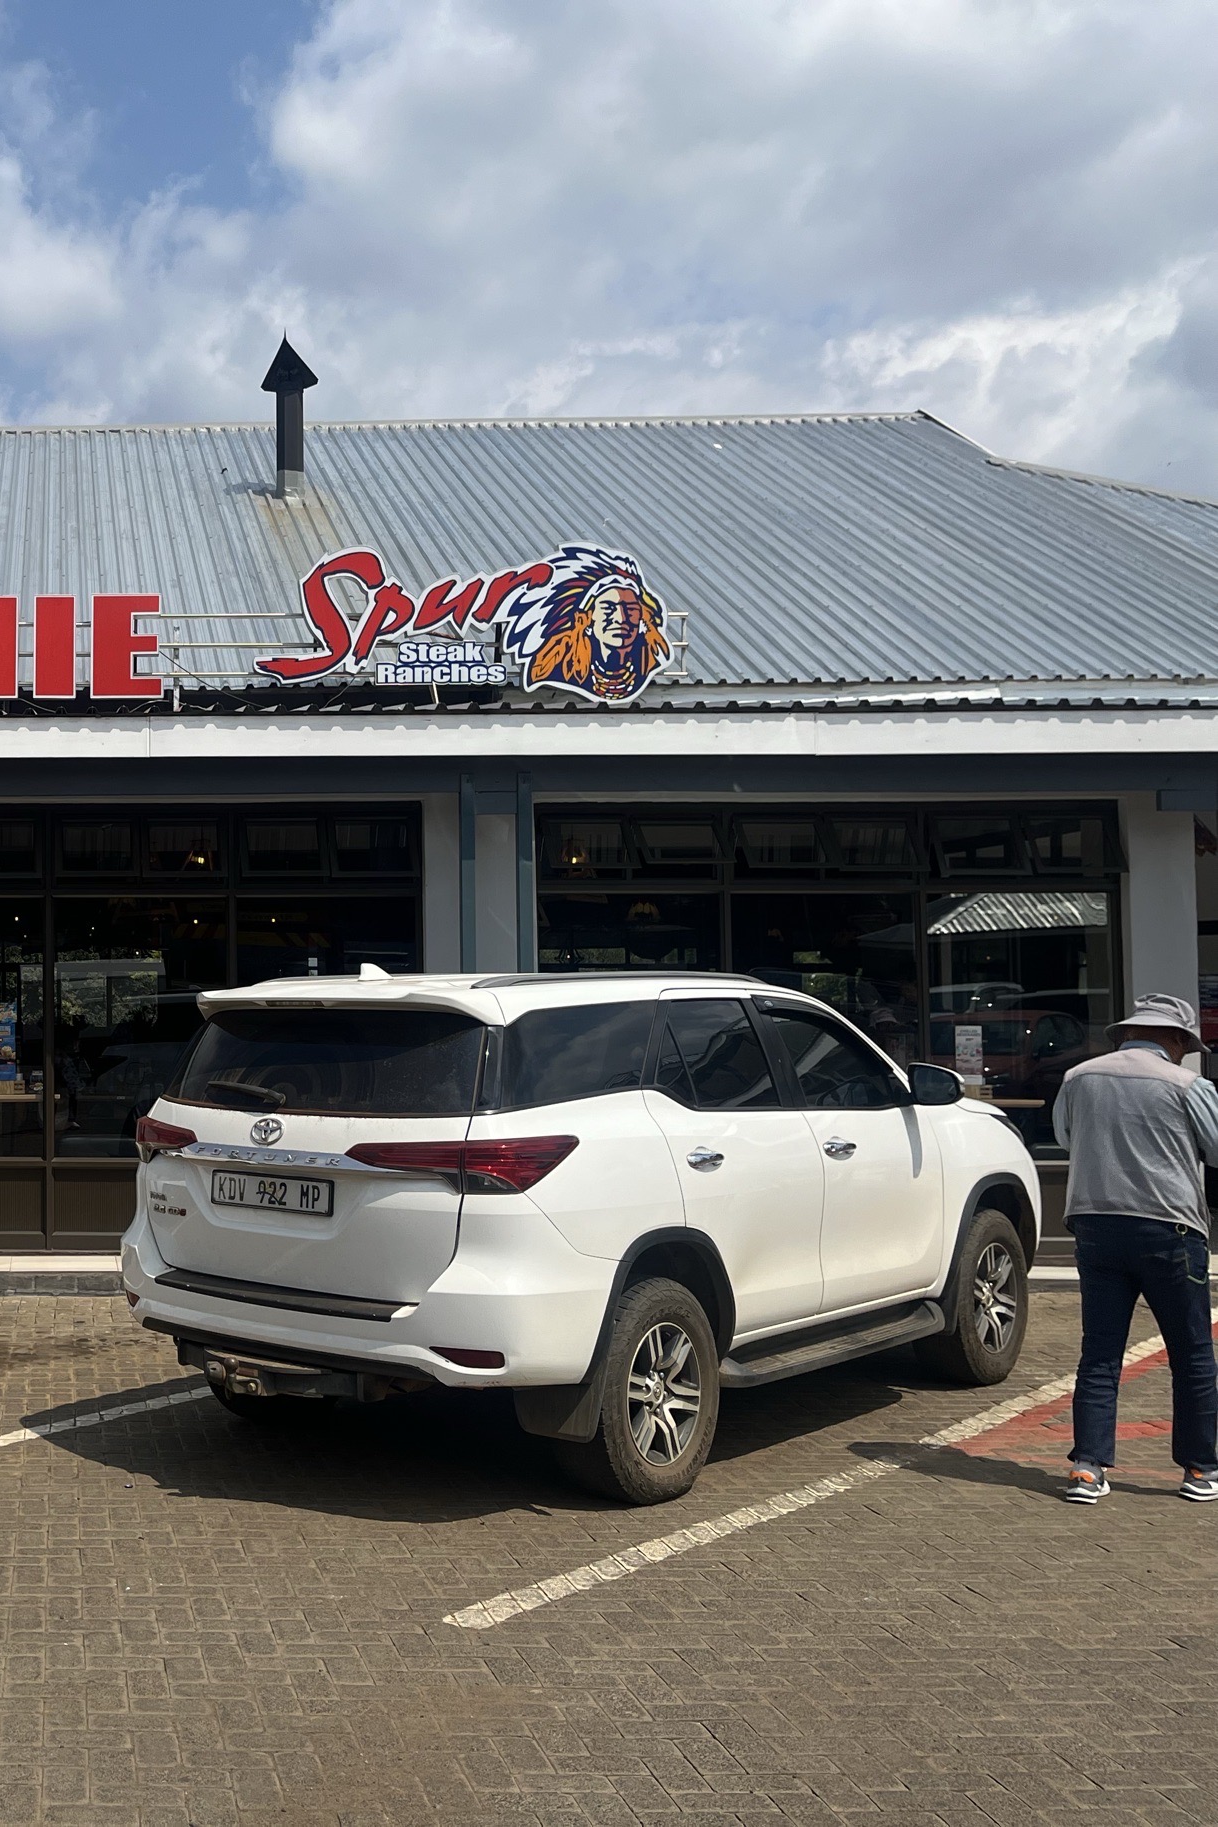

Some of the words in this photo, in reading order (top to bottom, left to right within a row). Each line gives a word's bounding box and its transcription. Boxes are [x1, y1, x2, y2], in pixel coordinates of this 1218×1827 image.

[255, 549, 555, 680] Spur
[398, 642, 486, 664] Steak
[375, 662, 507, 685] Ranches
[194, 1146, 341, 1167] FORTUNER
[218, 1176, 246, 1202] KDV
[300, 1183, 320, 1209] MP
